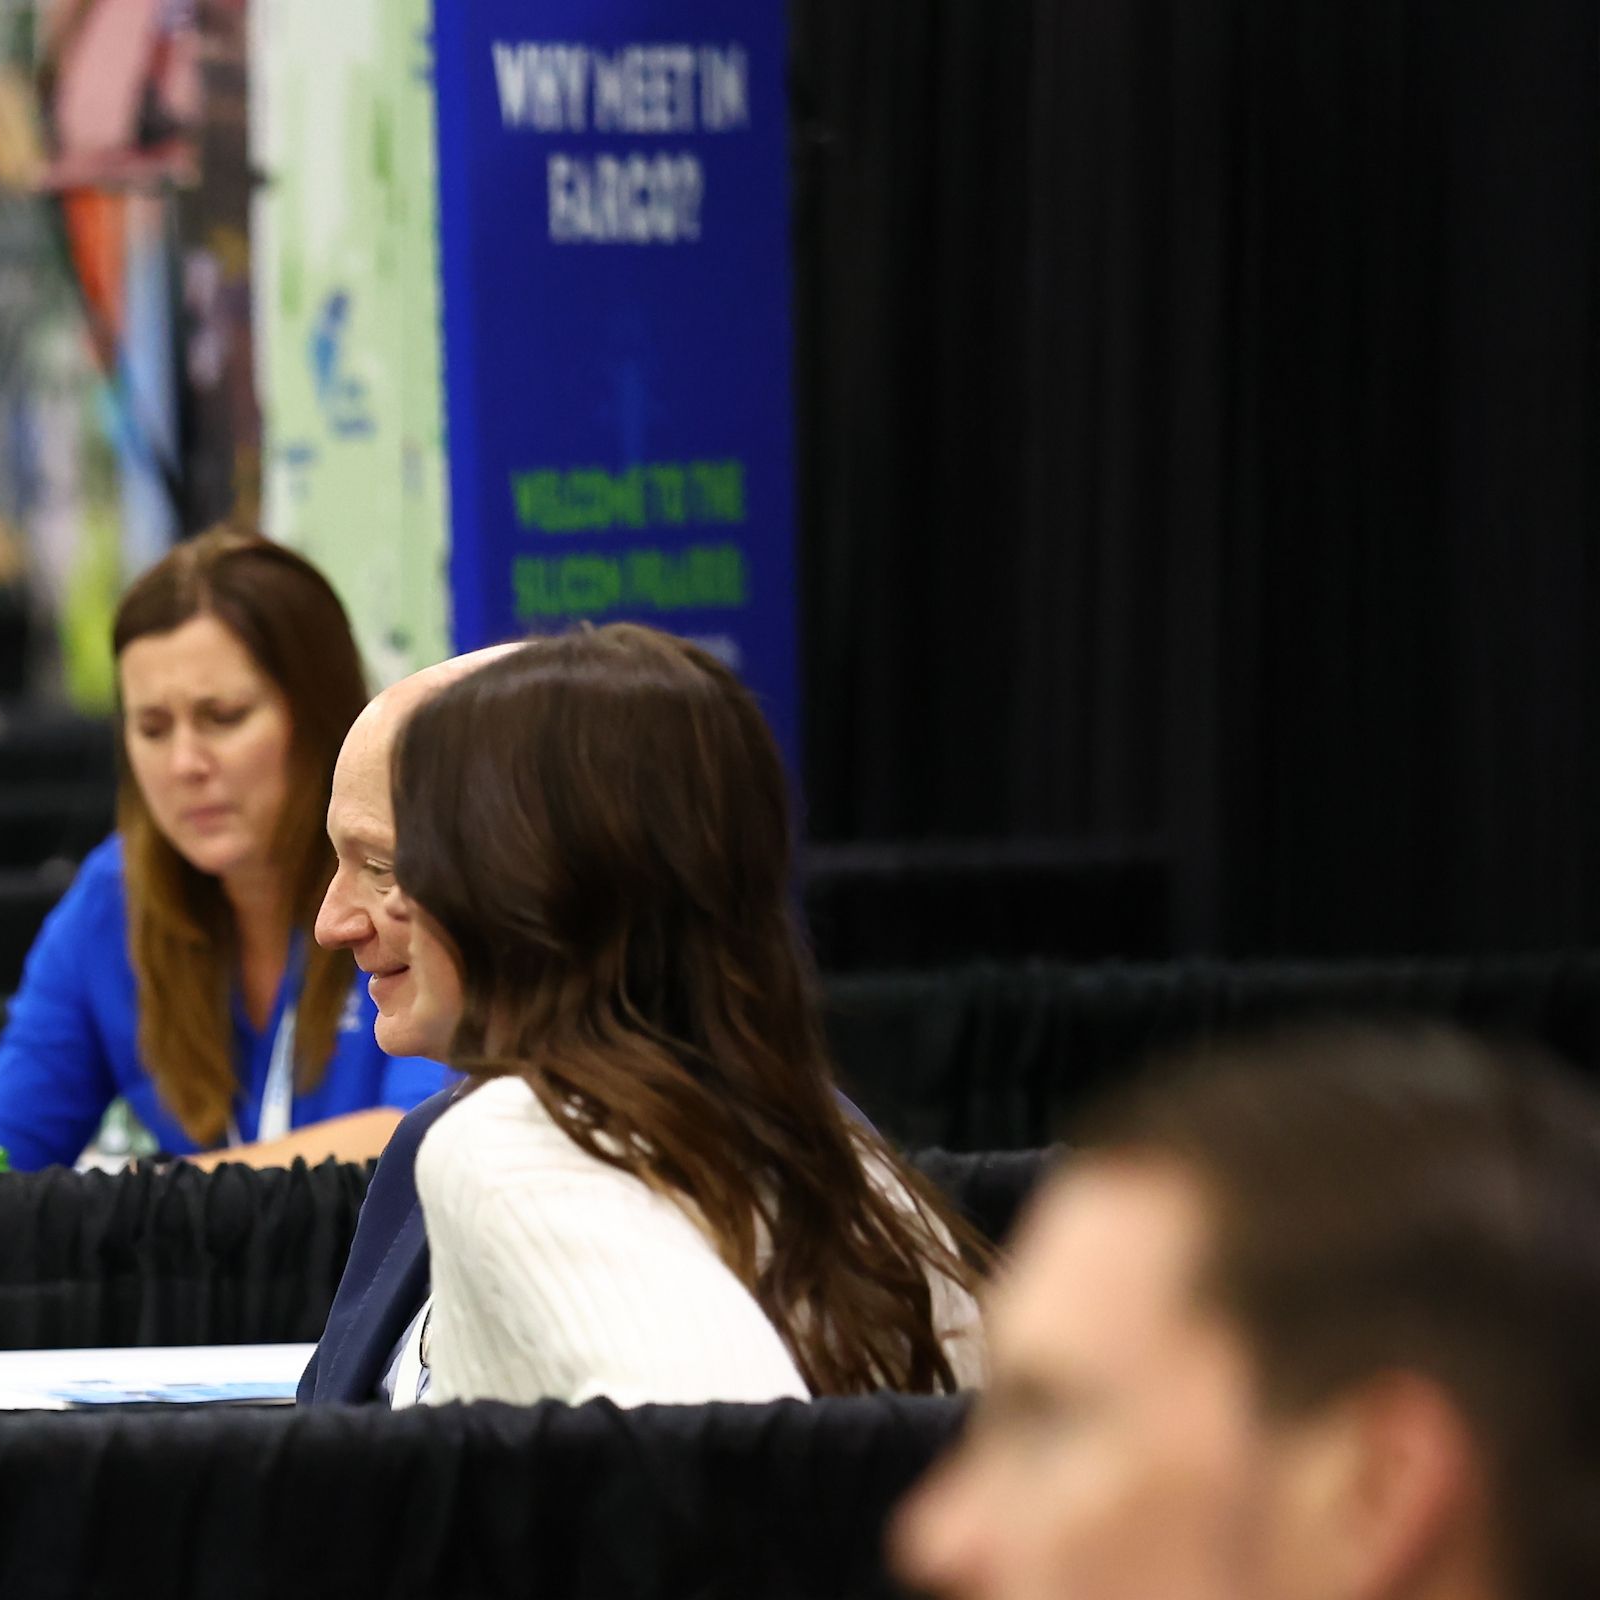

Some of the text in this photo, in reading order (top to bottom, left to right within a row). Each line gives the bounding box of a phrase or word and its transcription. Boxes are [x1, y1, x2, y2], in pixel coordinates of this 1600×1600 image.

[492, 44, 748, 132] WHY MEET IN
[547, 154, 704, 243] FARGO?
